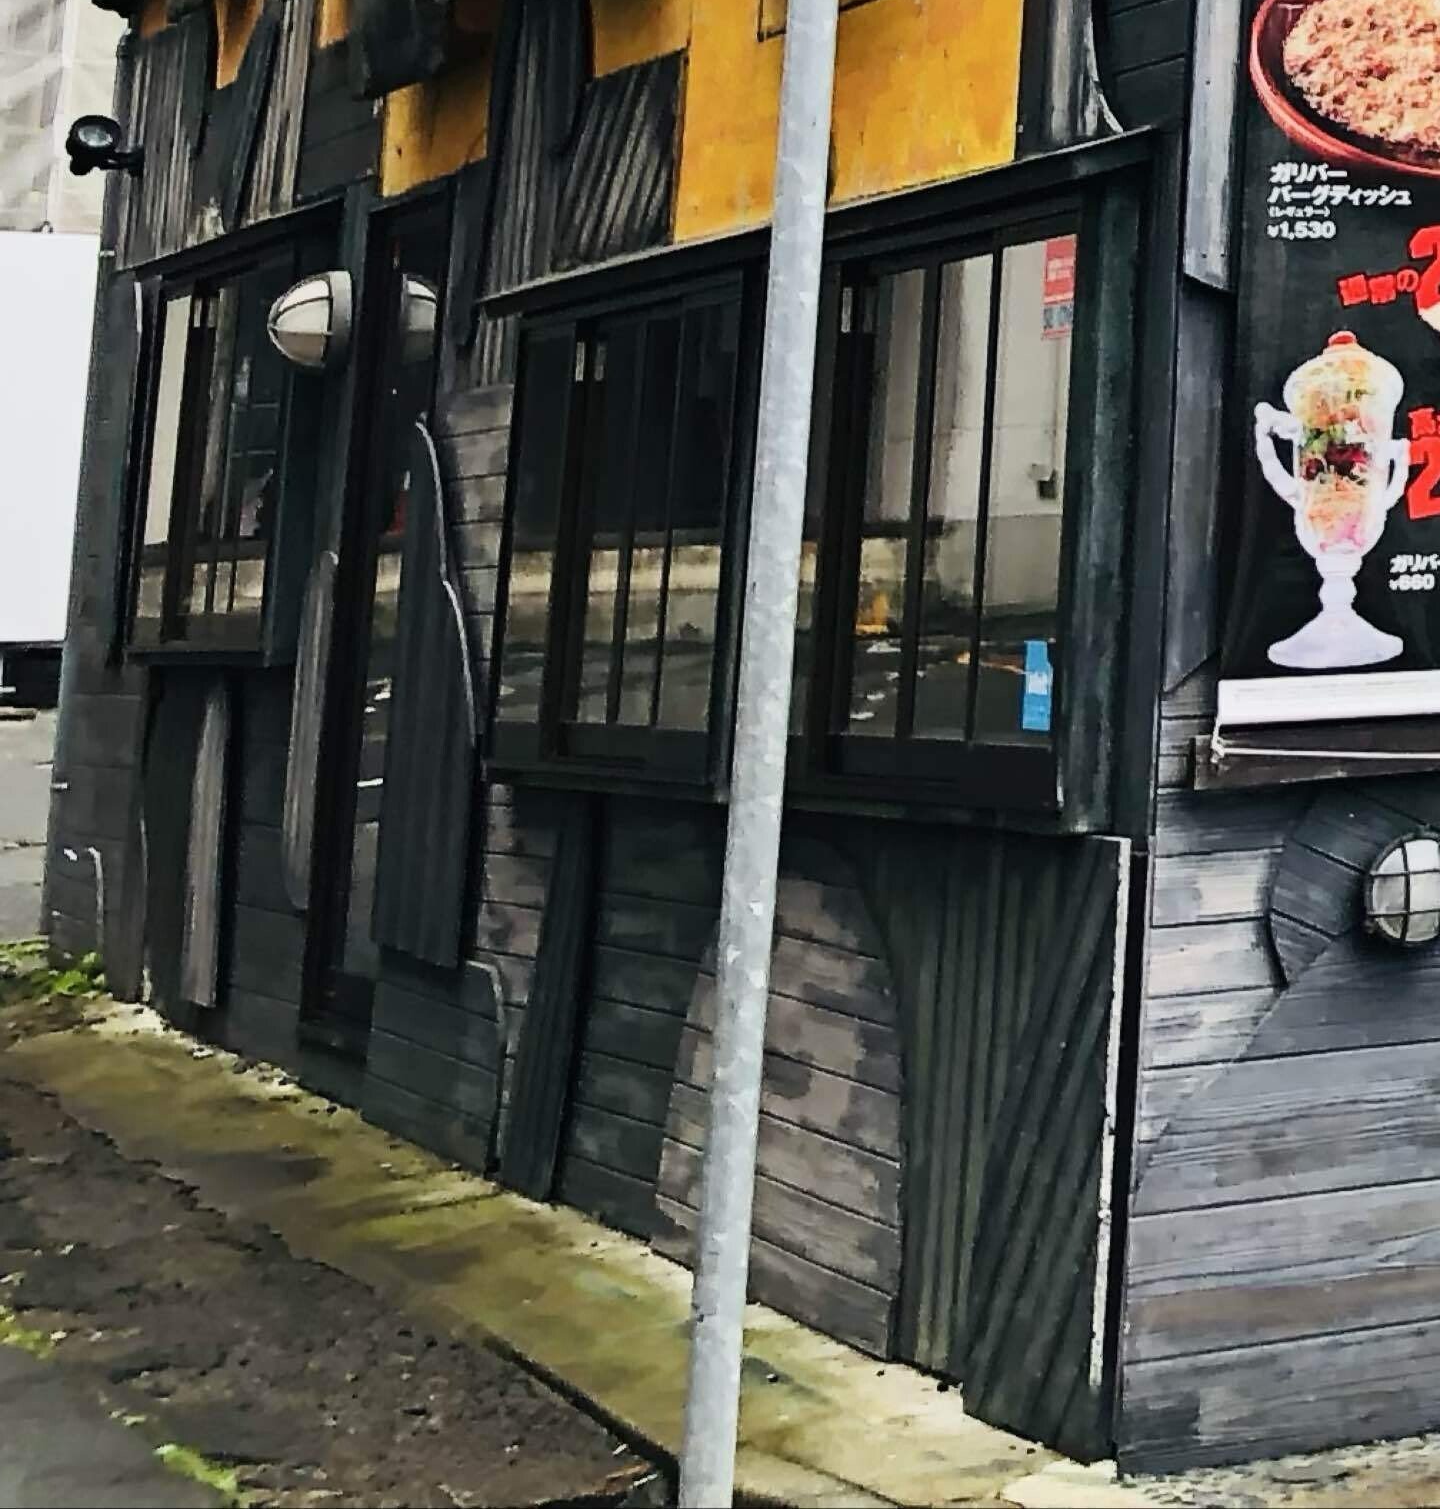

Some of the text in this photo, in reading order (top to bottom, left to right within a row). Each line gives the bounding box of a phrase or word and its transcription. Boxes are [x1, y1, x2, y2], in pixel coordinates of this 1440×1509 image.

[1269, 162, 1348, 184] ガリバー
[1267, 184, 1412, 206] バーグディッシュ
[1267, 221, 1336, 240] ¥1,530
